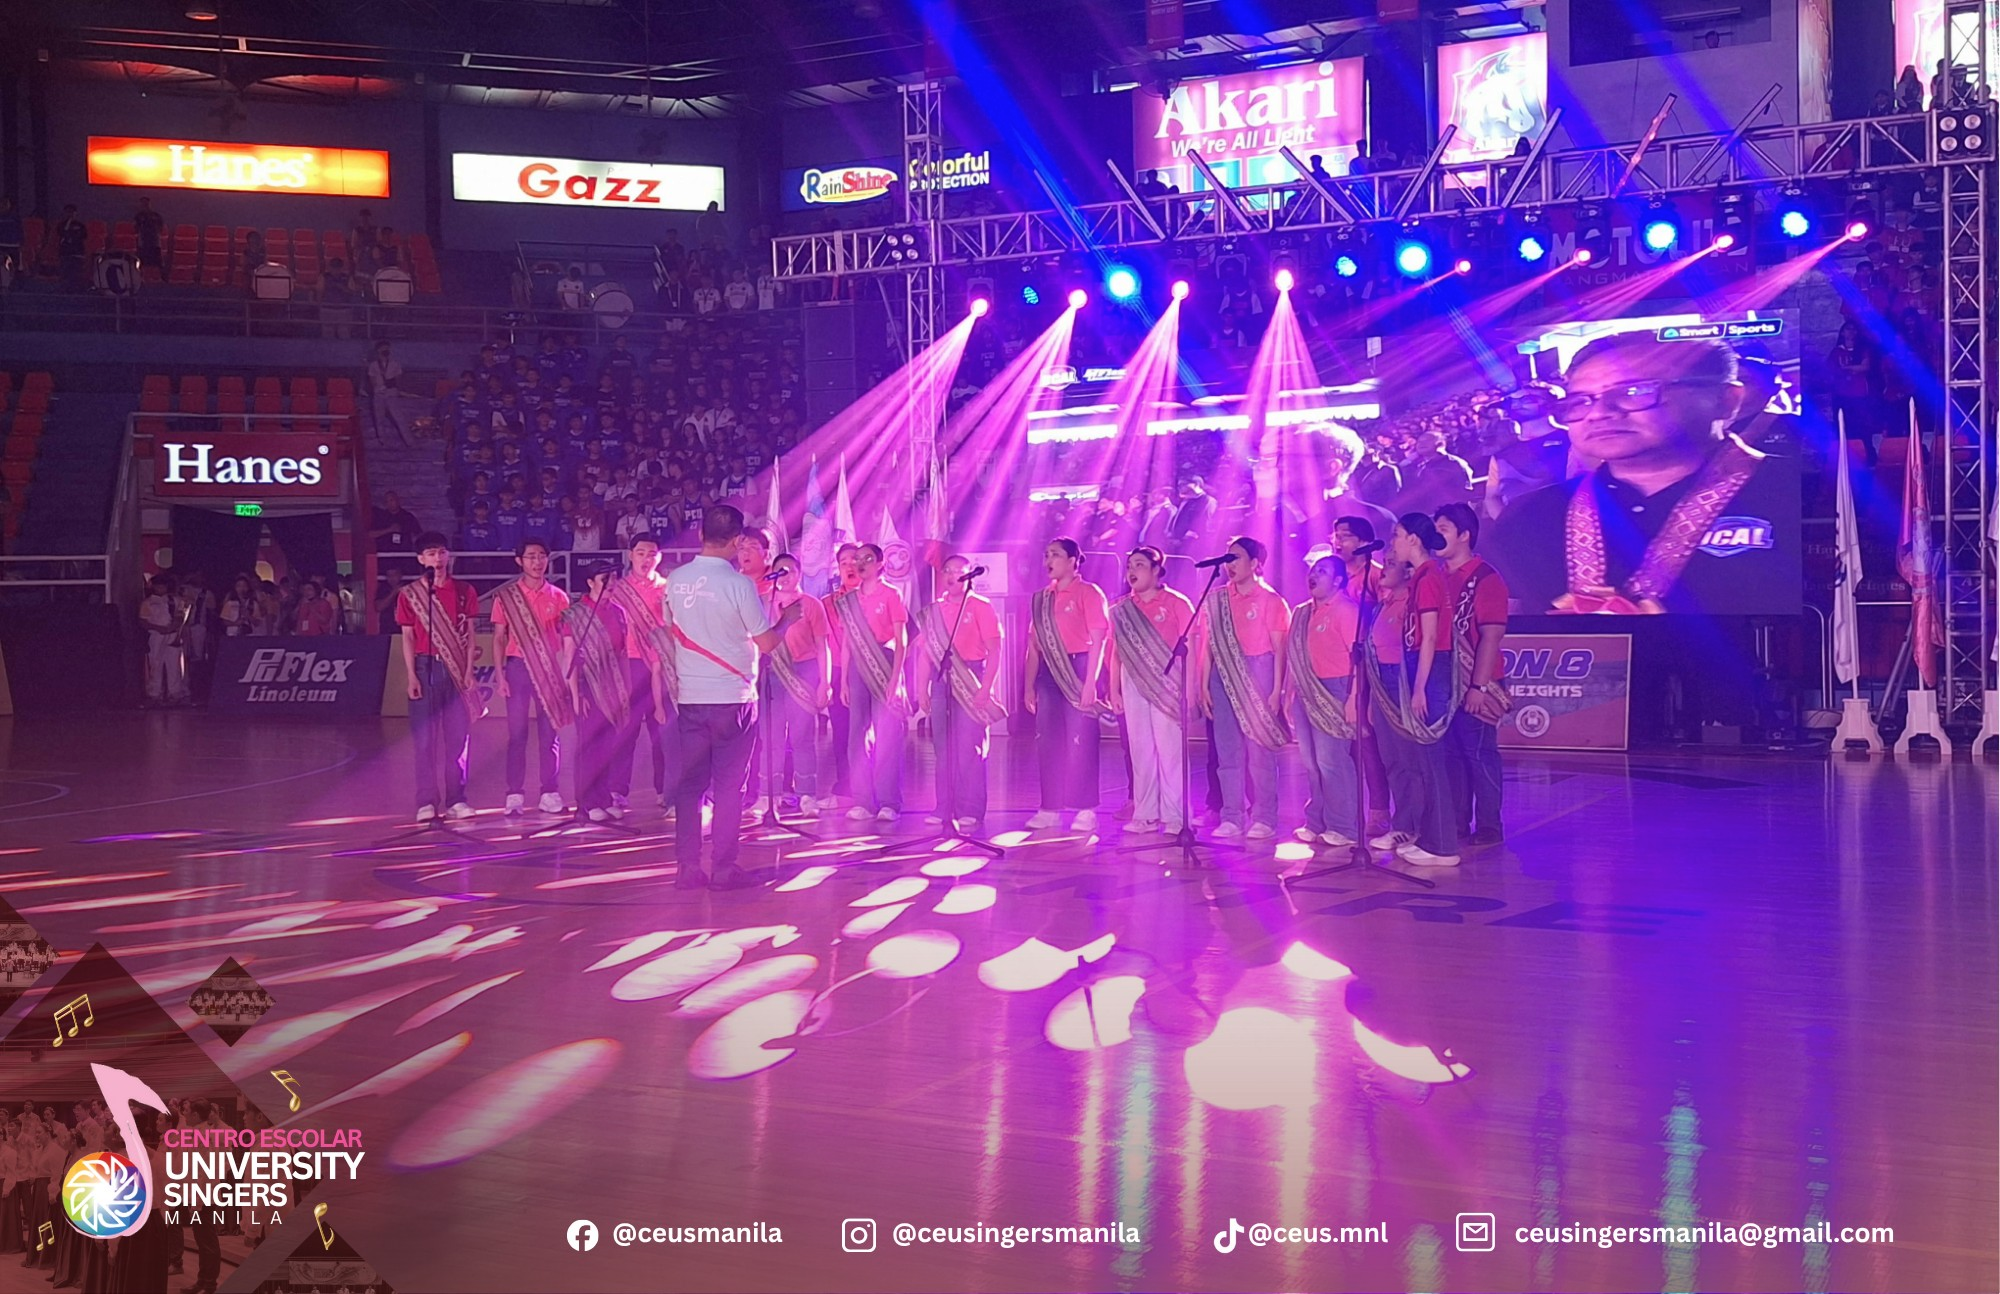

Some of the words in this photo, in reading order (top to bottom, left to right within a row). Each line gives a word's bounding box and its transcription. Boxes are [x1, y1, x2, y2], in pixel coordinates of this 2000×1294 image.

[1154, 61, 1338, 138] Akari
[1171, 138, 1226, 158] We're
[1232, 131, 1259, 151] All
[1264, 124, 1317, 148] Light
[168, 144, 309, 187] Hanes
[518, 163, 662, 203] Gazz
[1679, 326, 1719, 337] Smart
[1728, 322, 1776, 334] Sports
[163, 443, 322, 485] Hanes
[651, 517, 668, 528] PCU
[684, 508, 703, 521] PCU
[672, 583, 696, 595] CEU
[1554, 649, 1594, 679] 8
[247, 685, 337, 702] Linoleum
[1509, 685, 1582, 697] HEIGHTS
